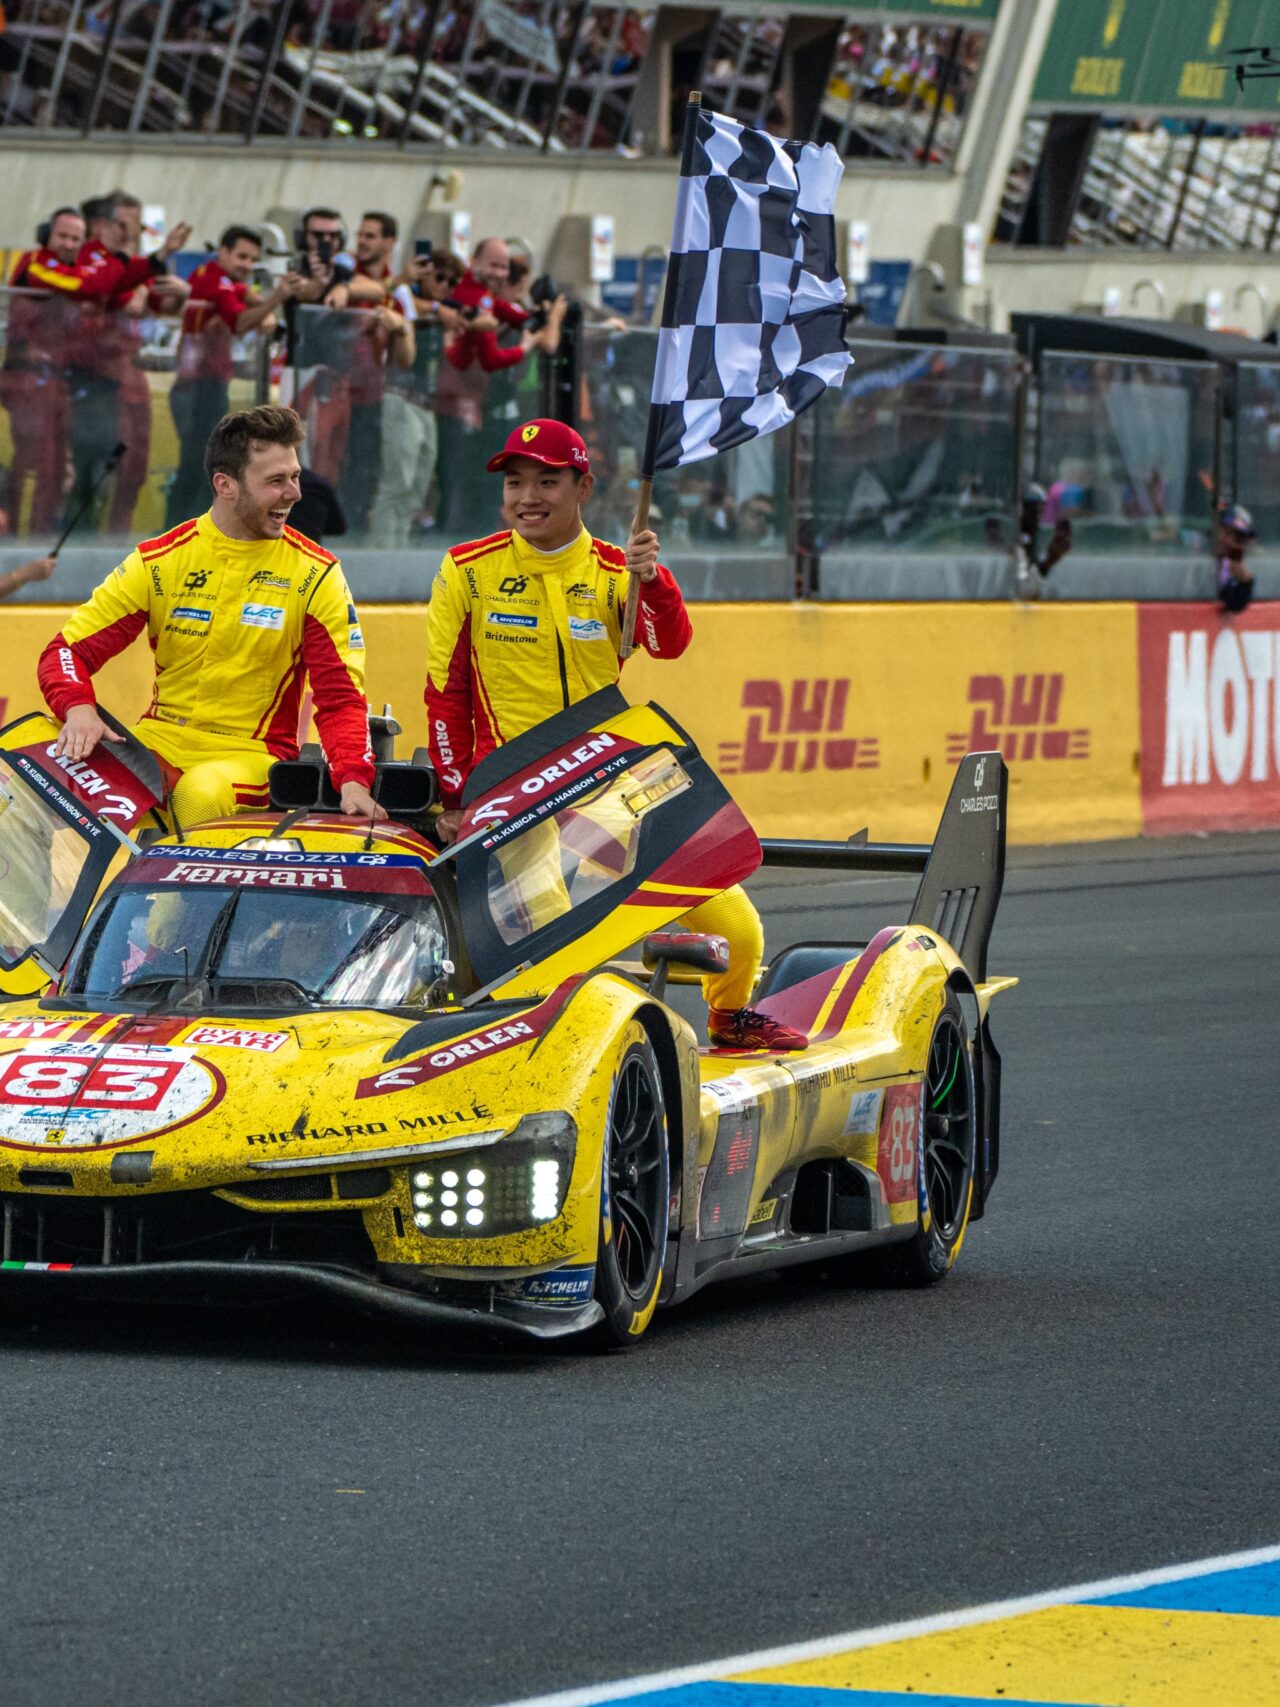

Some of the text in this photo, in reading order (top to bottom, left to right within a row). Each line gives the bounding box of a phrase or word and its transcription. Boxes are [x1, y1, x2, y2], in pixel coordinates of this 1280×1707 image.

[297, 565, 319, 597] Sabelt
[465, 568, 480, 599] Sabelt
[484, 594, 540, 606] CHARLES POZZI
[499, 616, 534, 625] MICHELIN
[484, 631, 539, 644] Britestone
[741, 678, 859, 772] DHL
[966, 673, 1072, 764] DHL
[434, 719, 455, 766] ORLEN
[520, 732, 617, 794] ORLEN
[961, 796, 983, 814] CHARLES
[147, 846, 257, 861] CHARLES
[264, 852, 347, 864] POZZI
[159, 862, 347, 889] Ferrari
[192, 1034, 275, 1049] CAR
[200, 1028, 283, 1041] HYPER
[429, 1021, 534, 1068] ORLEN
[4, 1060, 170, 1101] 83
[246, 1103, 494, 1146] RICHARD MILLE
[890, 1104, 915, 1183] 83
